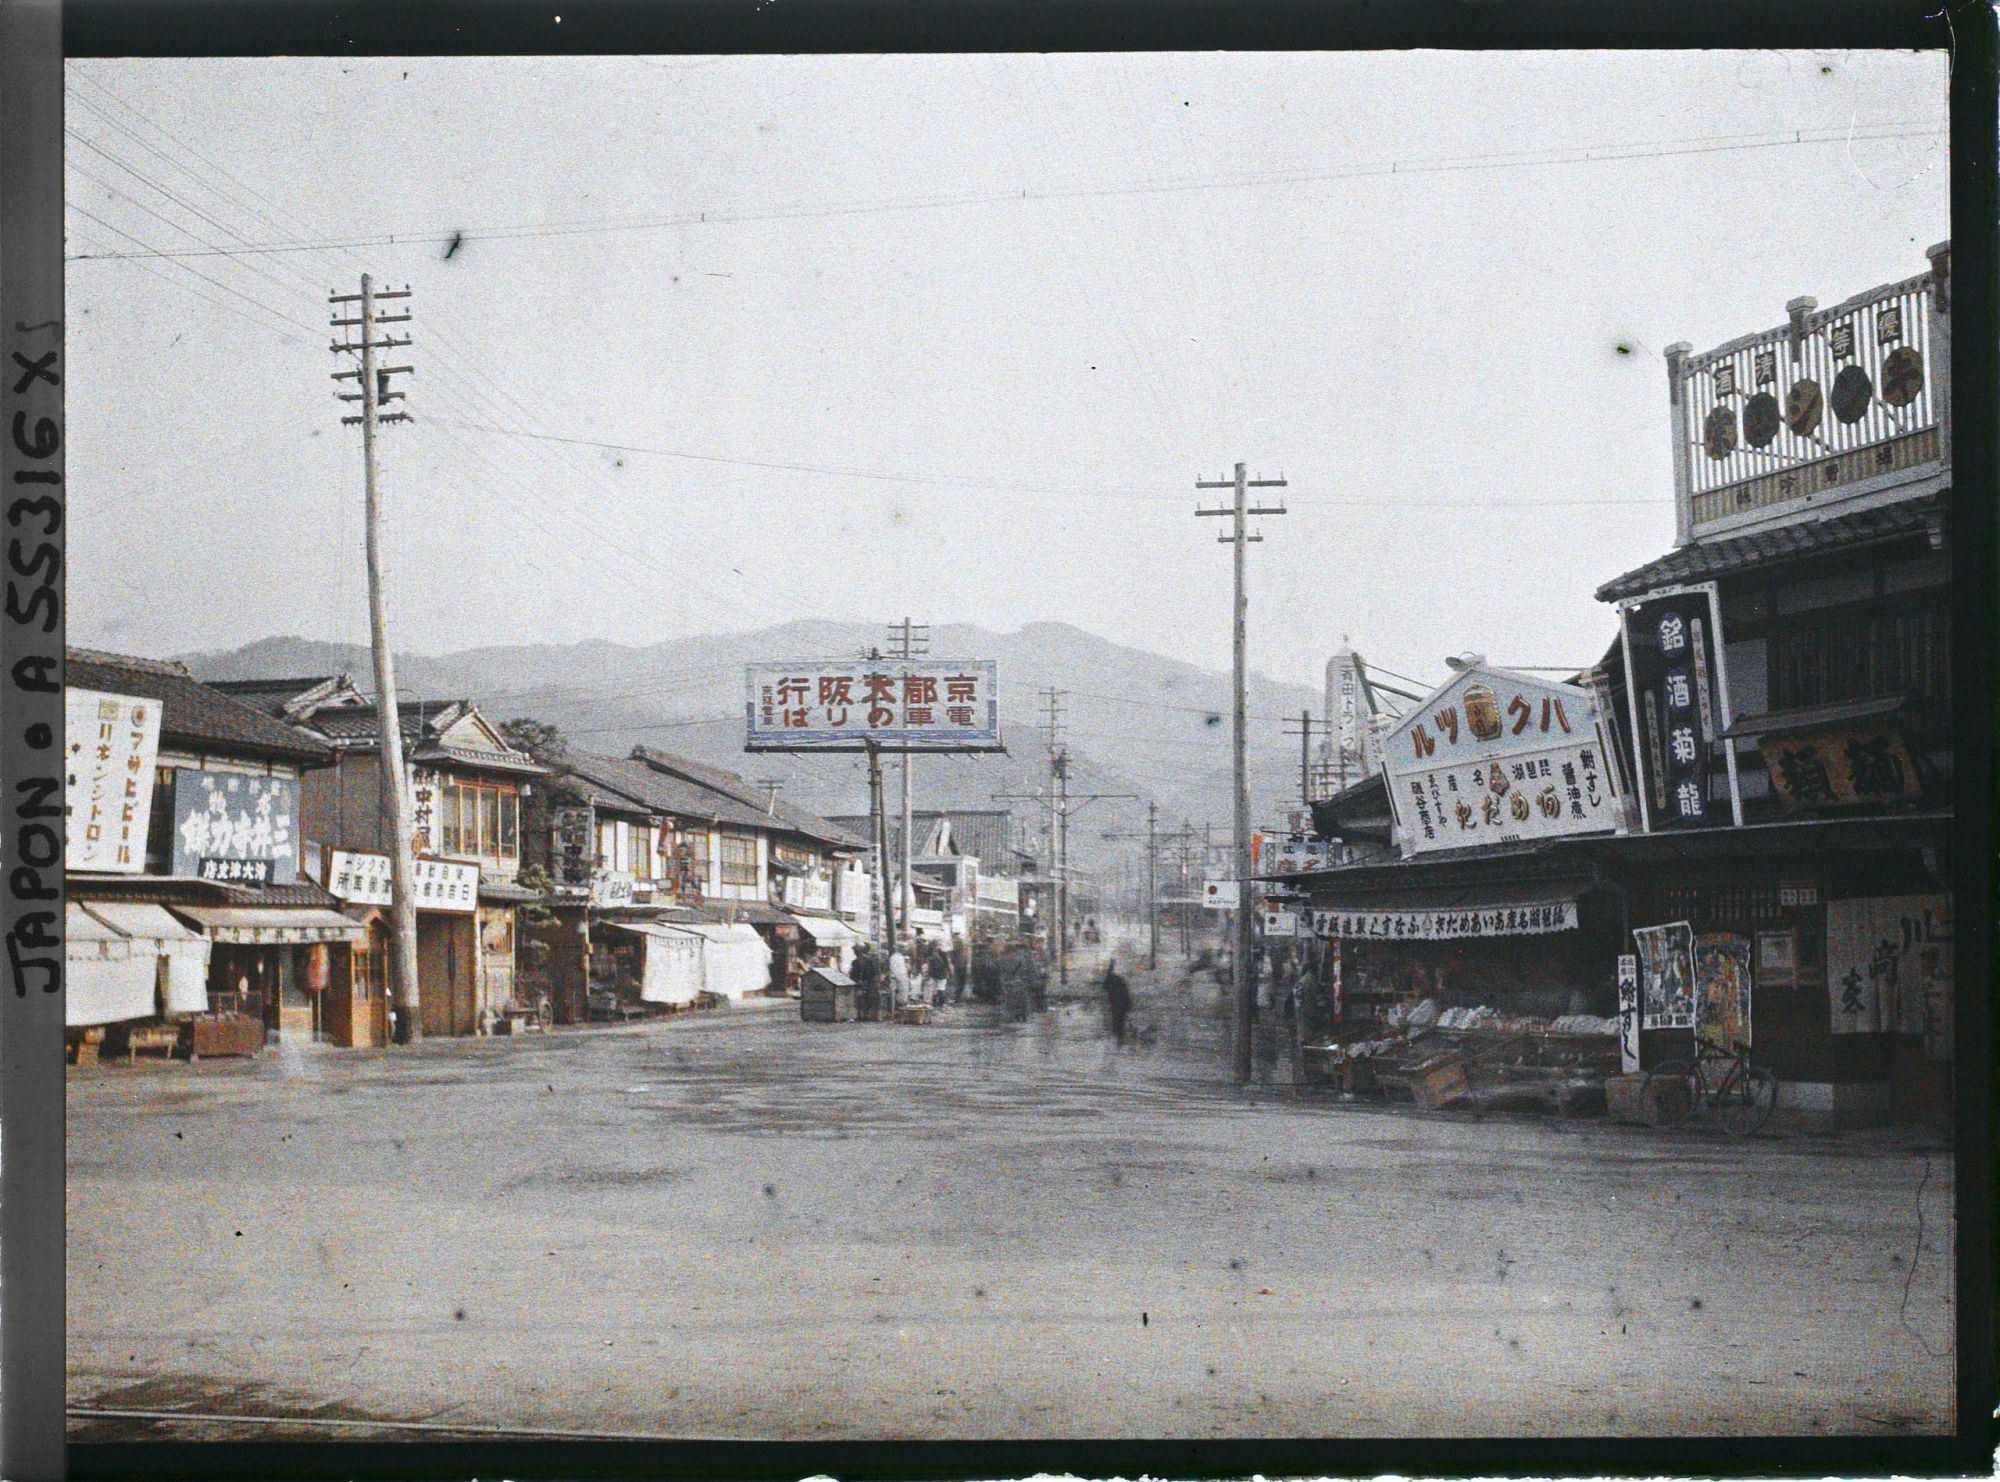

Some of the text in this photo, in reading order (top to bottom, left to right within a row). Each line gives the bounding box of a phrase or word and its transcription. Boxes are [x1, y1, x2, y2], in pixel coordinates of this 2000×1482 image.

[11, 656, 61, 693] A
[777, 674, 978, 707] 京都大阪行
[783, 705, 975, 728] 電車のりば
[6, 777, 61, 998] JAPON
